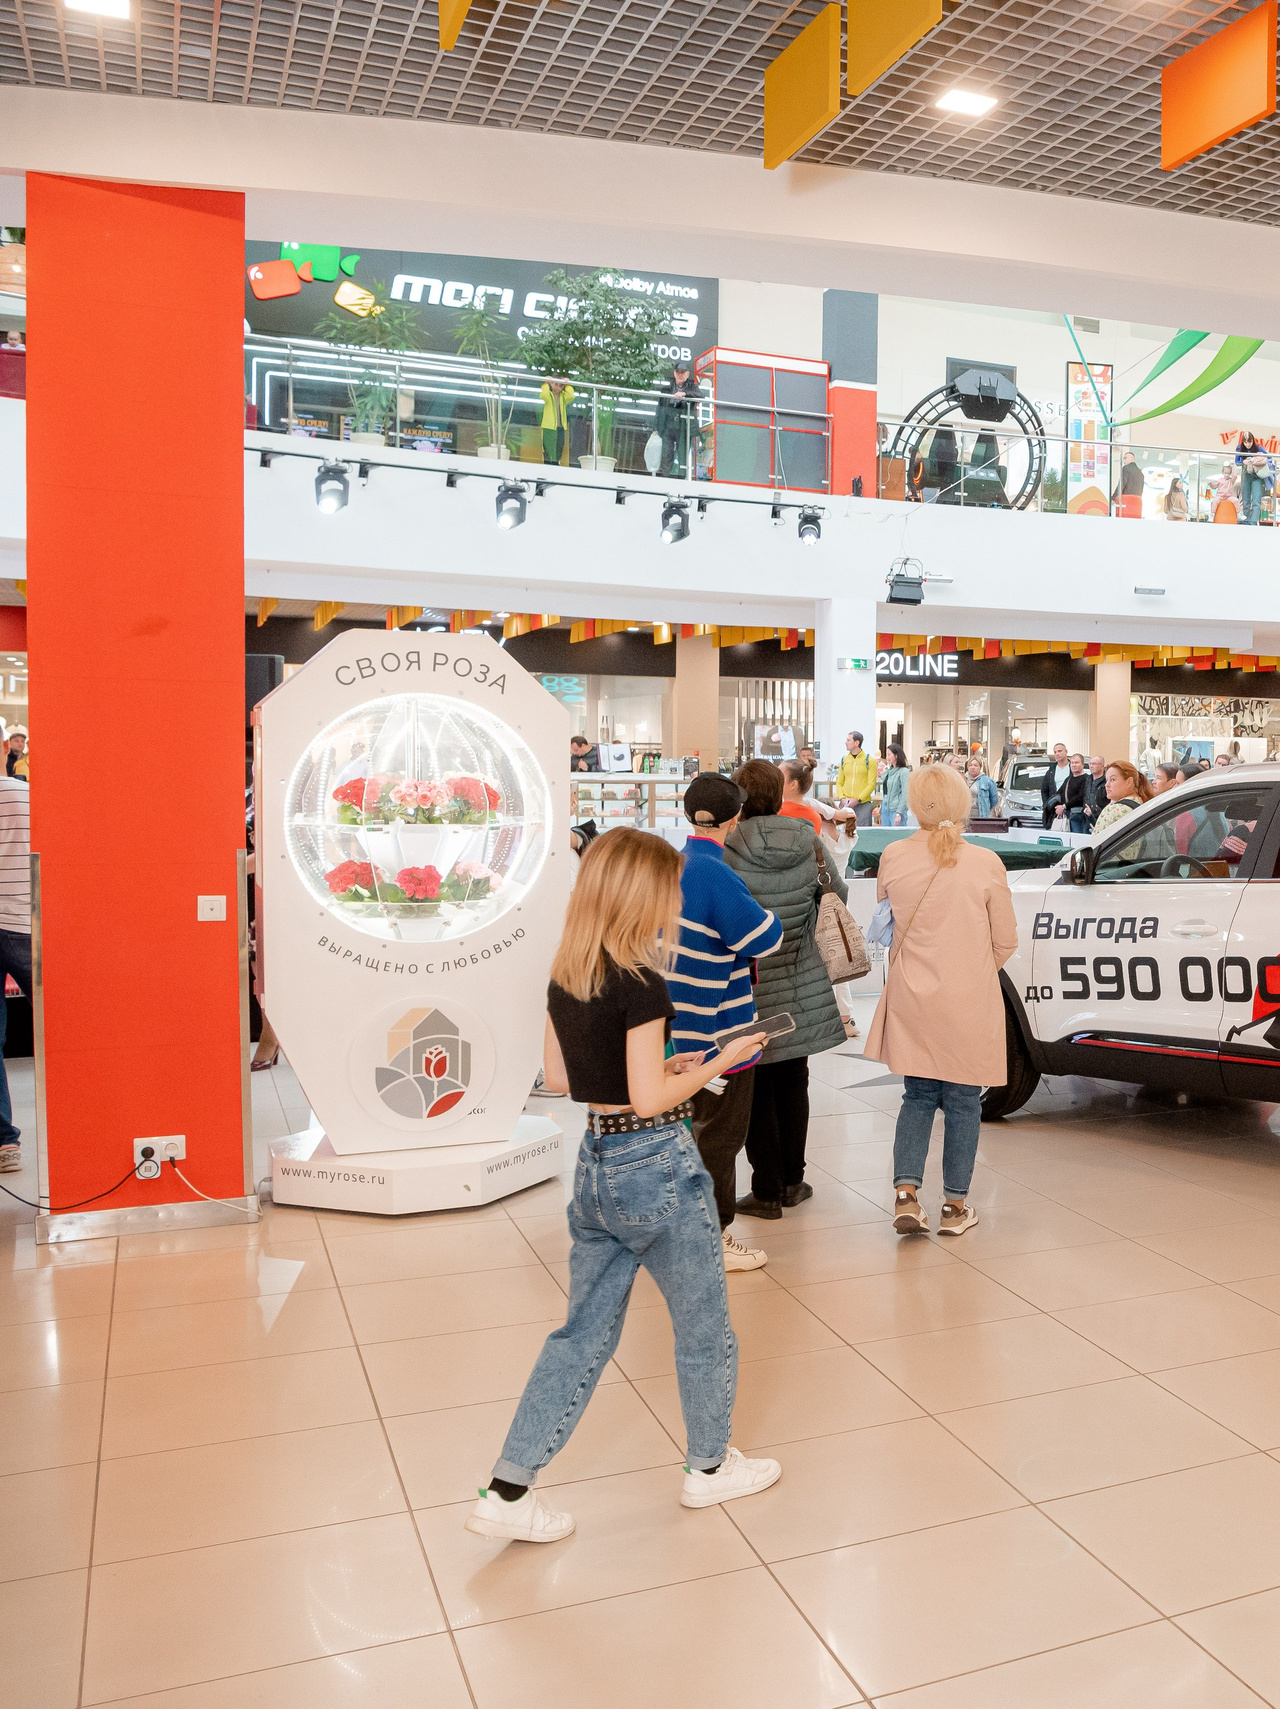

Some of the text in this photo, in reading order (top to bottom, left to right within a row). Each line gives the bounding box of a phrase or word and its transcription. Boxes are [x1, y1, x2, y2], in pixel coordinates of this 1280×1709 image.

[655, 280, 699, 300] Atmos
[335, 650, 507, 695] СВОЯ РОЗА
[1031, 912, 1160, 944] Выгода
[317, 927, 526, 974] ВЫРАЩЕНО С ЛЮБОВЬЮ
[1025, 985, 1053, 1003] до
[1059, 956, 1161, 1003] 590
[487, 1138, 559, 1175] www.myrose.ru
[281, 1166, 386, 1186] www.myrose.ru
